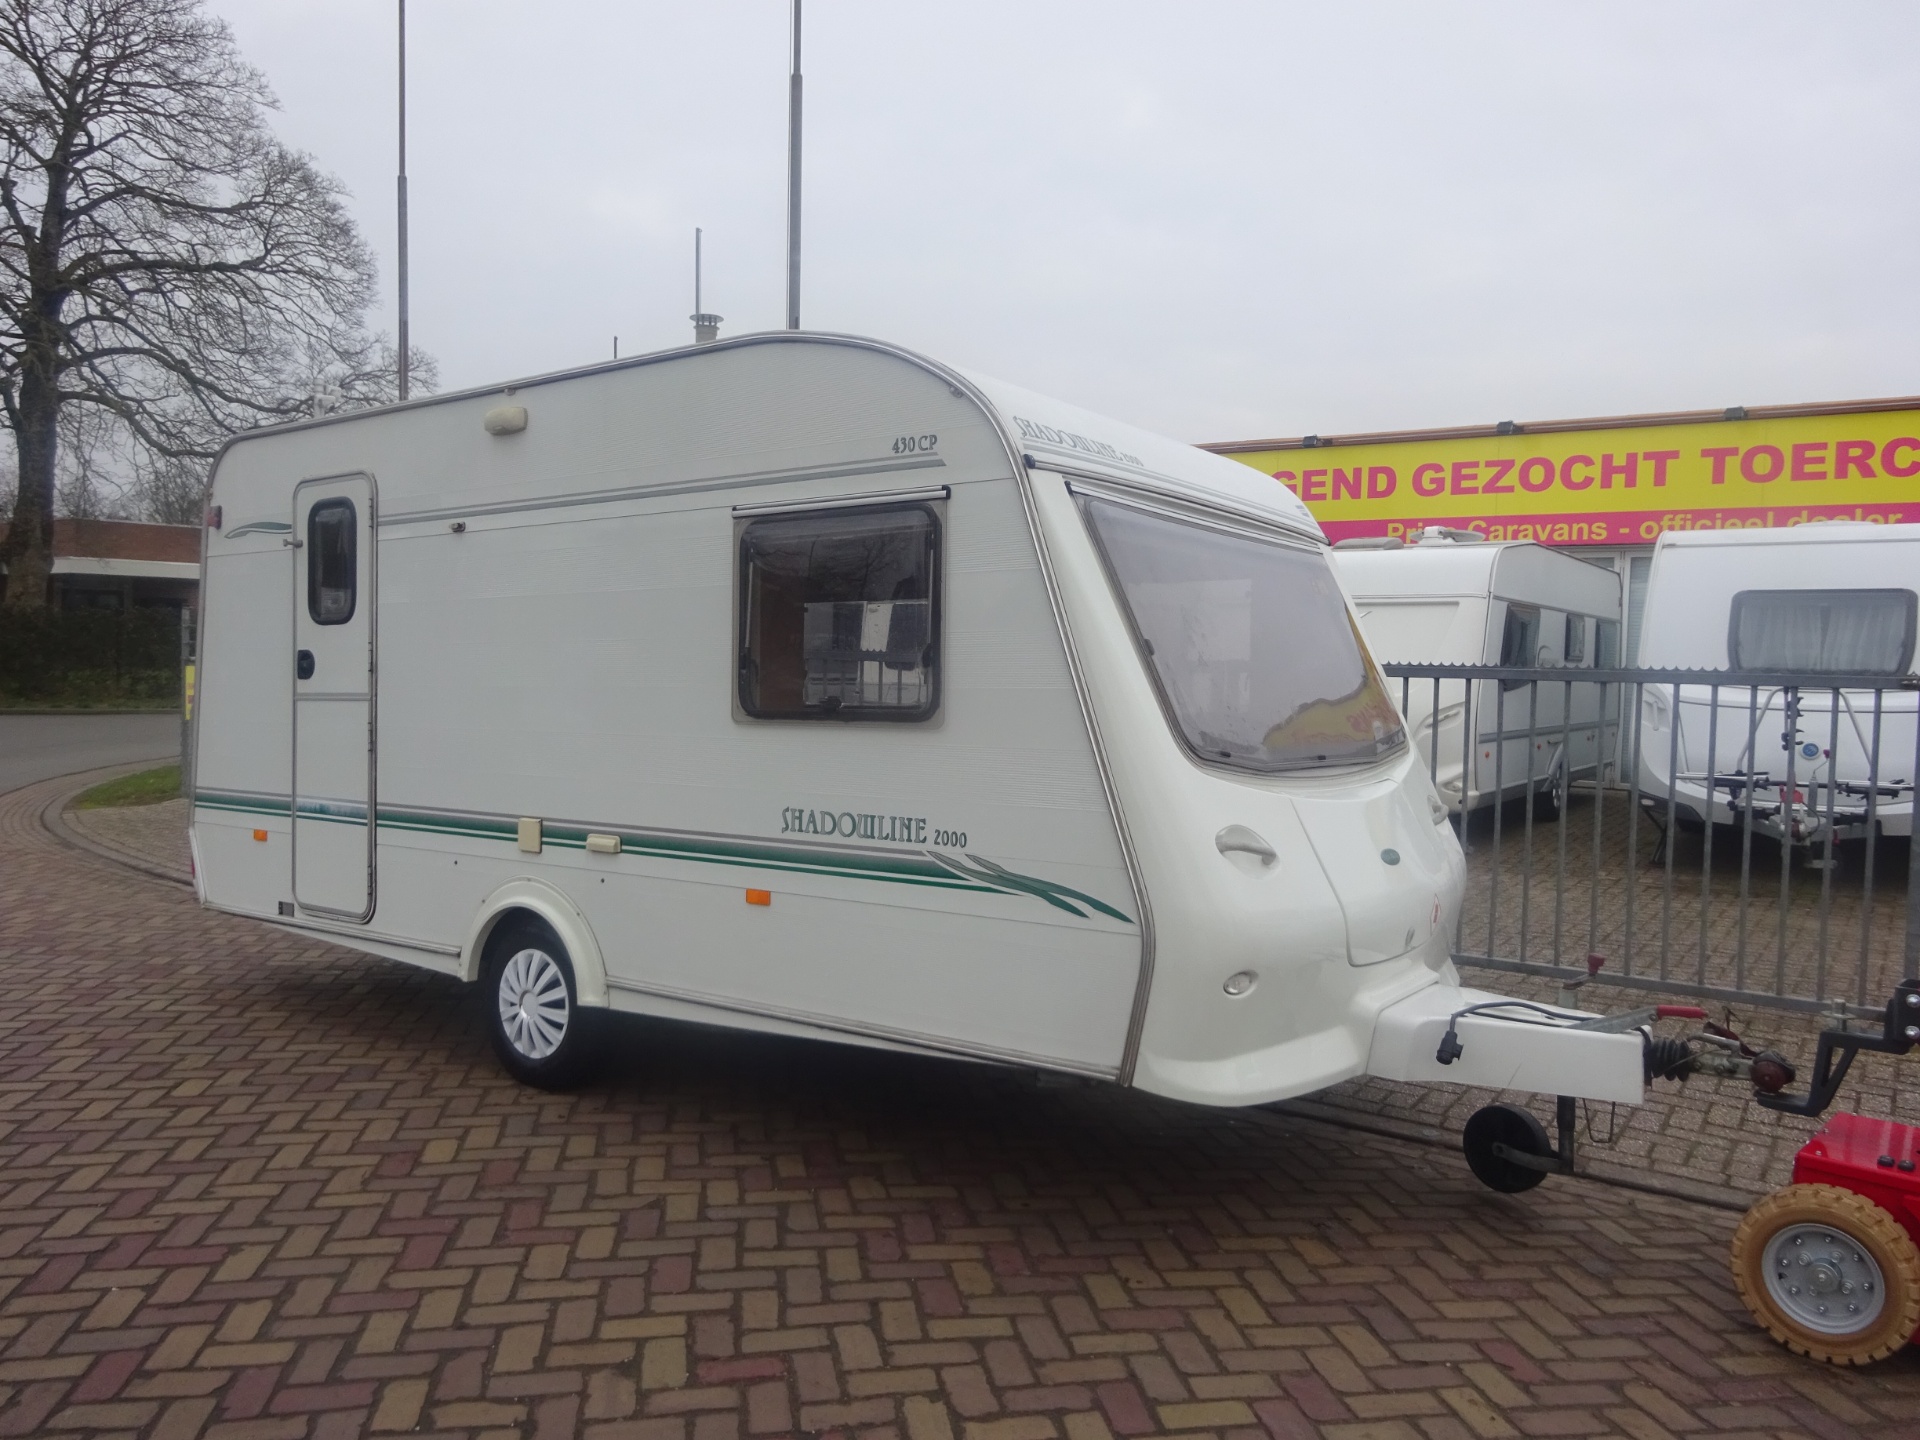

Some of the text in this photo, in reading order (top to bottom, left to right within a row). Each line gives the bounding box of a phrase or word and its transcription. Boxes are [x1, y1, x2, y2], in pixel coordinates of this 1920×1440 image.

[892, 434, 938, 453] 430 CP
[1412, 450, 1680, 497] GEZOCHT
[1701, 437, 1920, 484] TOERC
[782, 806, 967, 848] SHADOWLINE 2000
